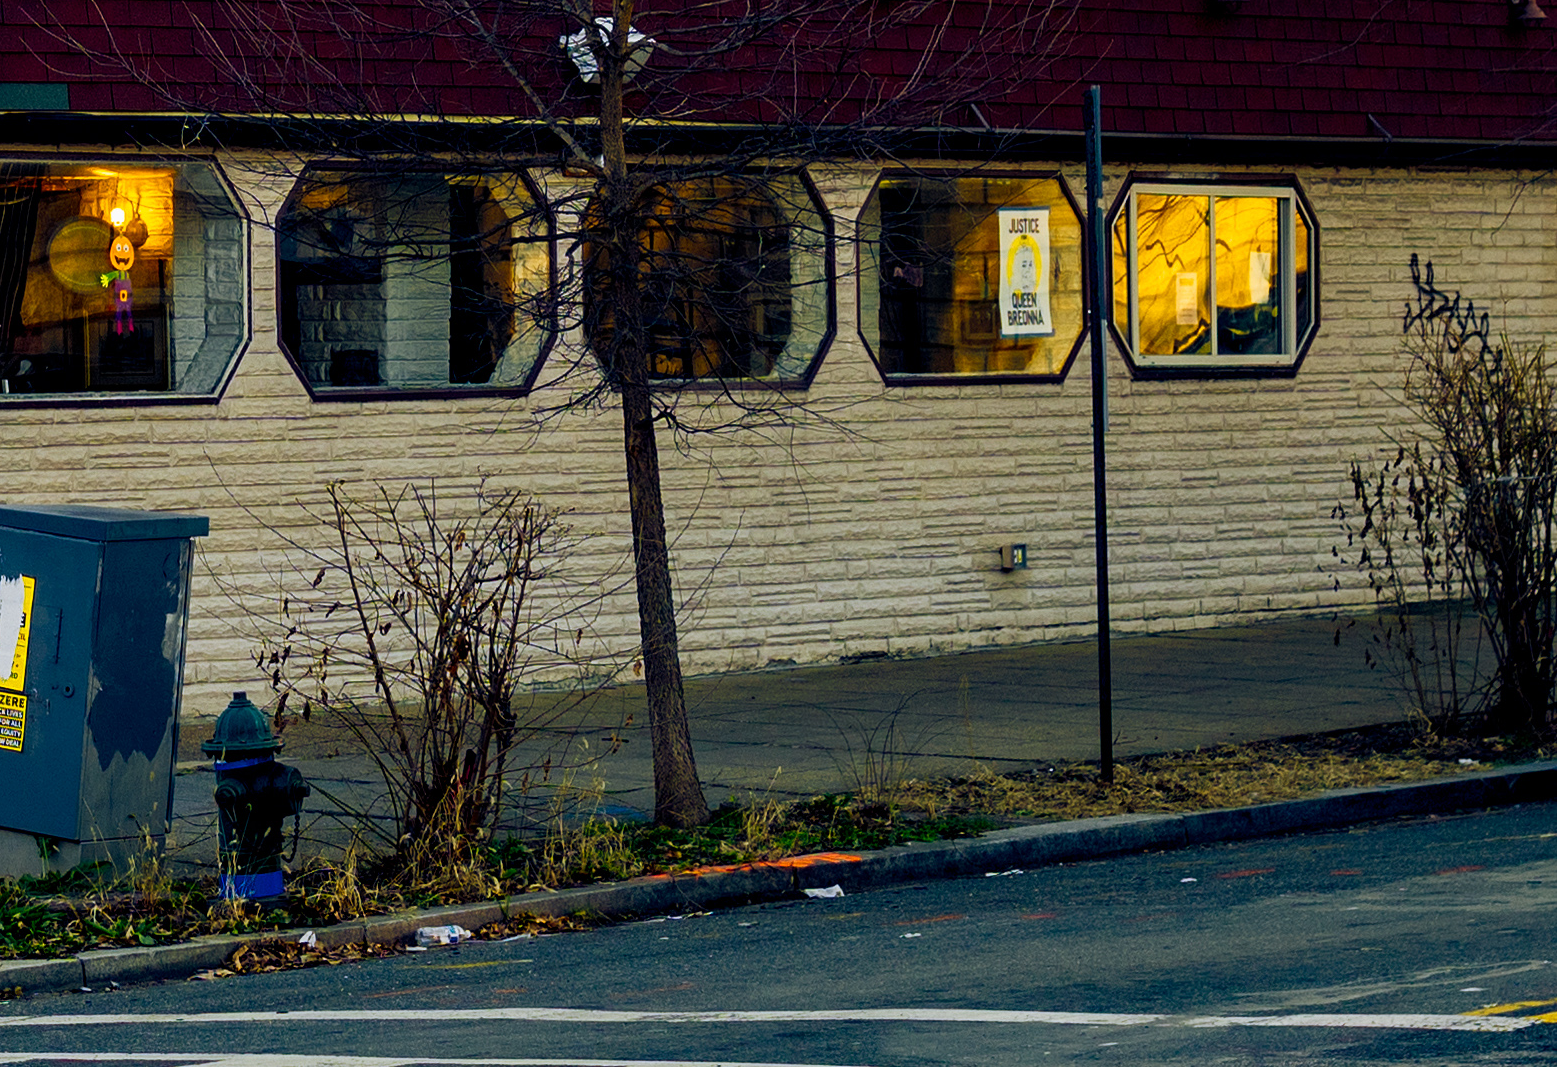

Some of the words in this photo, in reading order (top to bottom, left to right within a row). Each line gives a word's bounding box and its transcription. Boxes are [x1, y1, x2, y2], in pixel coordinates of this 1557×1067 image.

[1009, 218, 1040, 234] JUSTICE
[1012, 292, 1037, 309] QUEEN
[1007, 310, 1044, 326] BREONNA
[5, 738, 19, 747] DEAL
